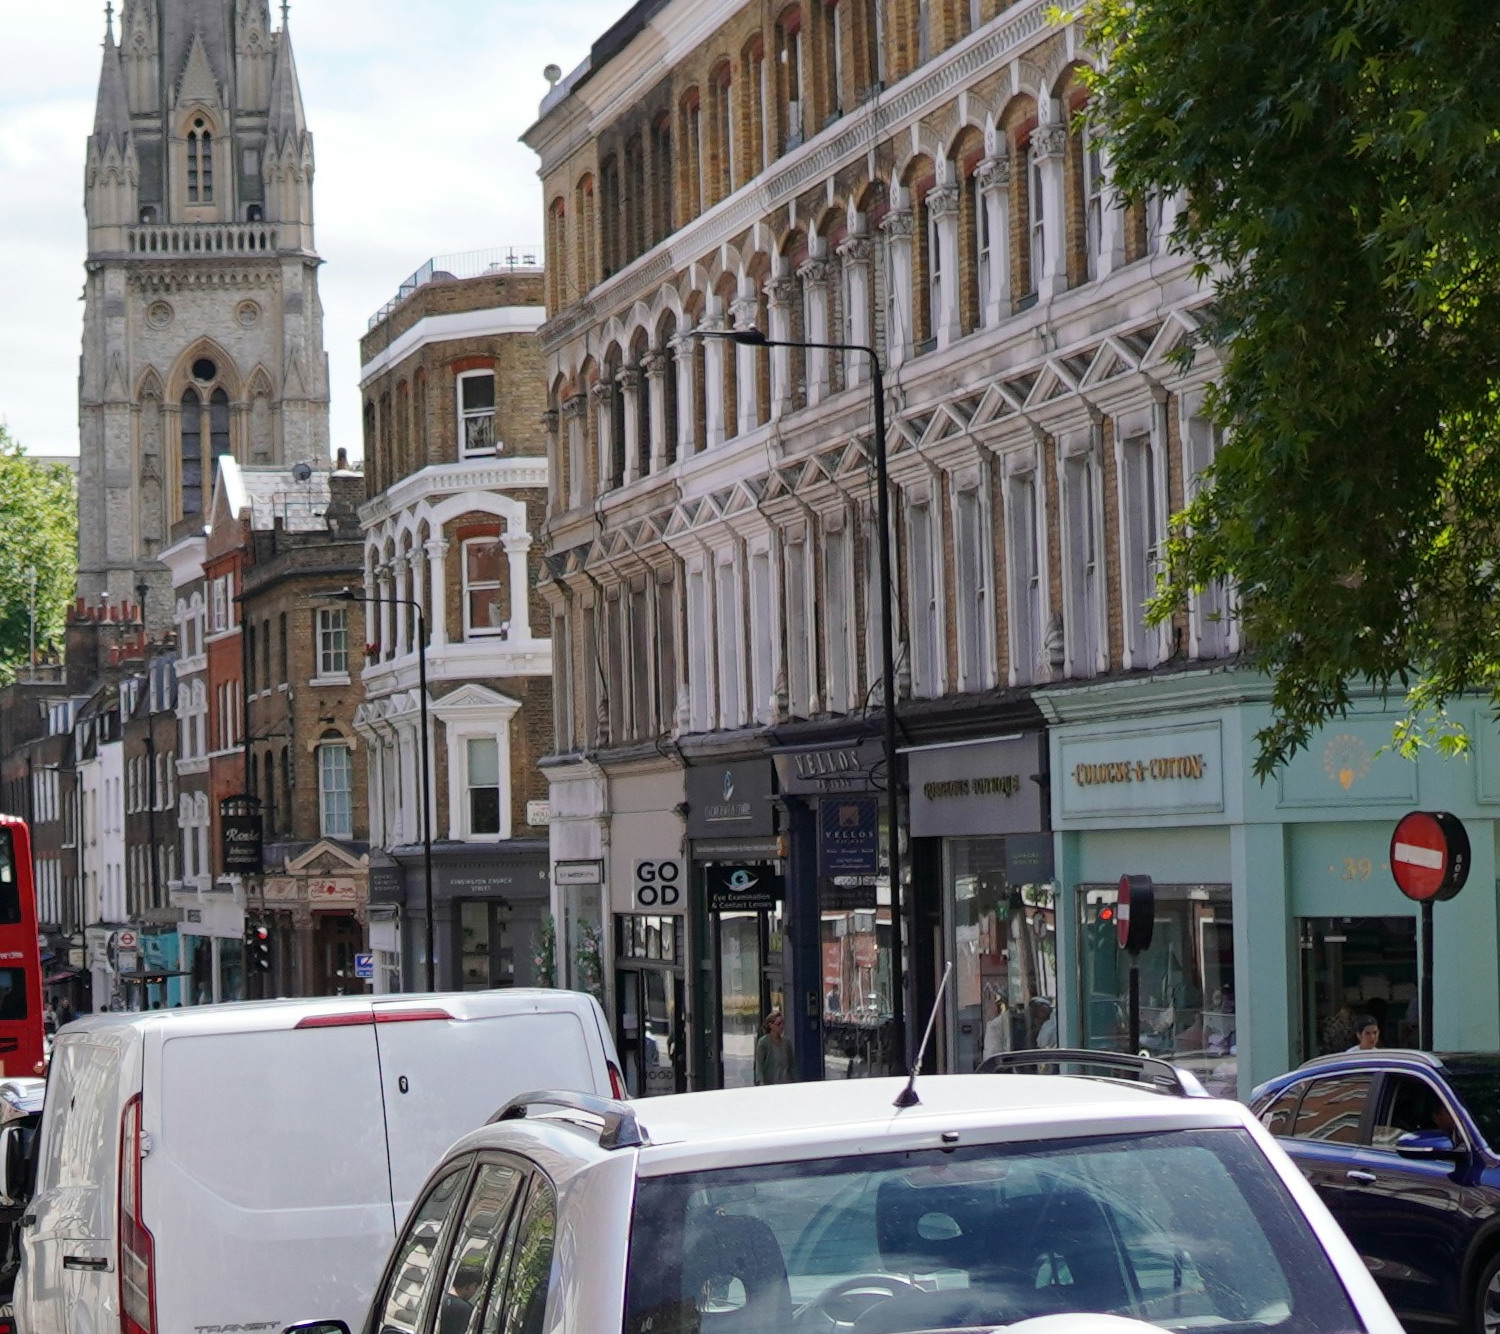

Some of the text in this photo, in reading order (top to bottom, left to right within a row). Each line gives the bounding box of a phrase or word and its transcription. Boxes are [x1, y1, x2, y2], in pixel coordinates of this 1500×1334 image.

[794, 750, 861, 778] VELLOS
[1075, 761, 1132, 787] COLOGNE
[1149, 754, 1204, 781] COTTON
[636, 861, 679, 882] GO
[1341, 858, 1373, 882] 39
[637, 885, 679, 906] OD
[713, 893, 771, 903] Eye Examination
[719, 901, 747, 909] Contact
